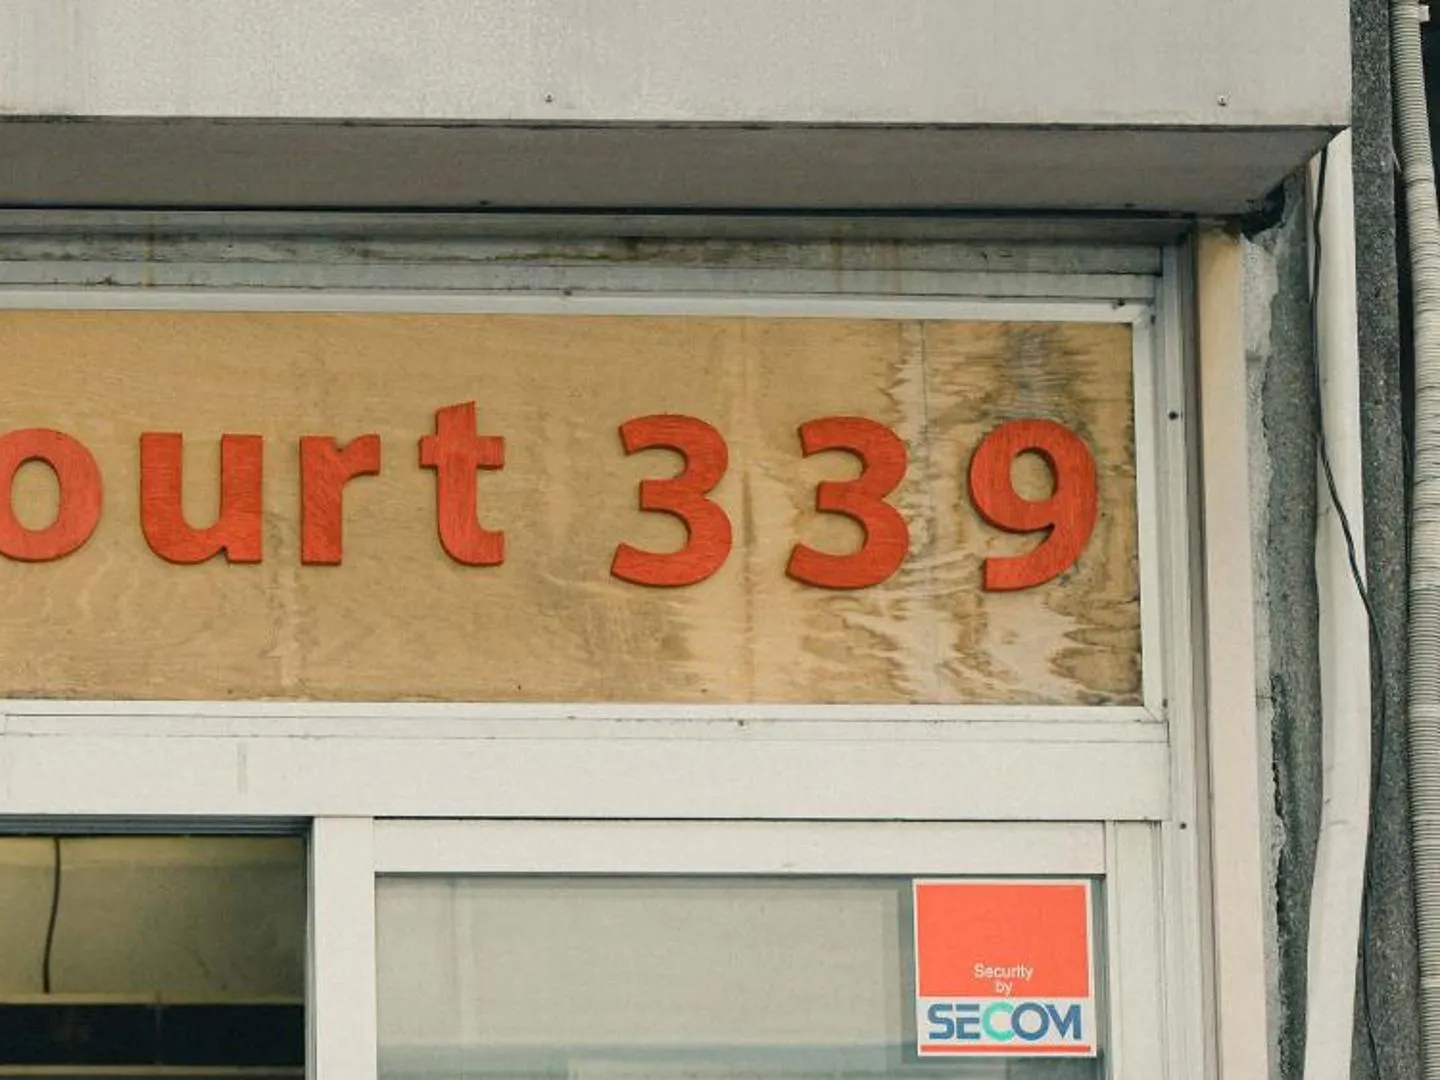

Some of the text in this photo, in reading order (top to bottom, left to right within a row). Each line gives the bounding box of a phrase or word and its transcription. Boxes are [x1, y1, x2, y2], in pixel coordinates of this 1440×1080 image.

[610, 414, 1100, 592] 339
[973, 963, 1034, 981] Security
[994, 981, 1014, 996] by
[926, 1001, 1082, 1041] SECOM
